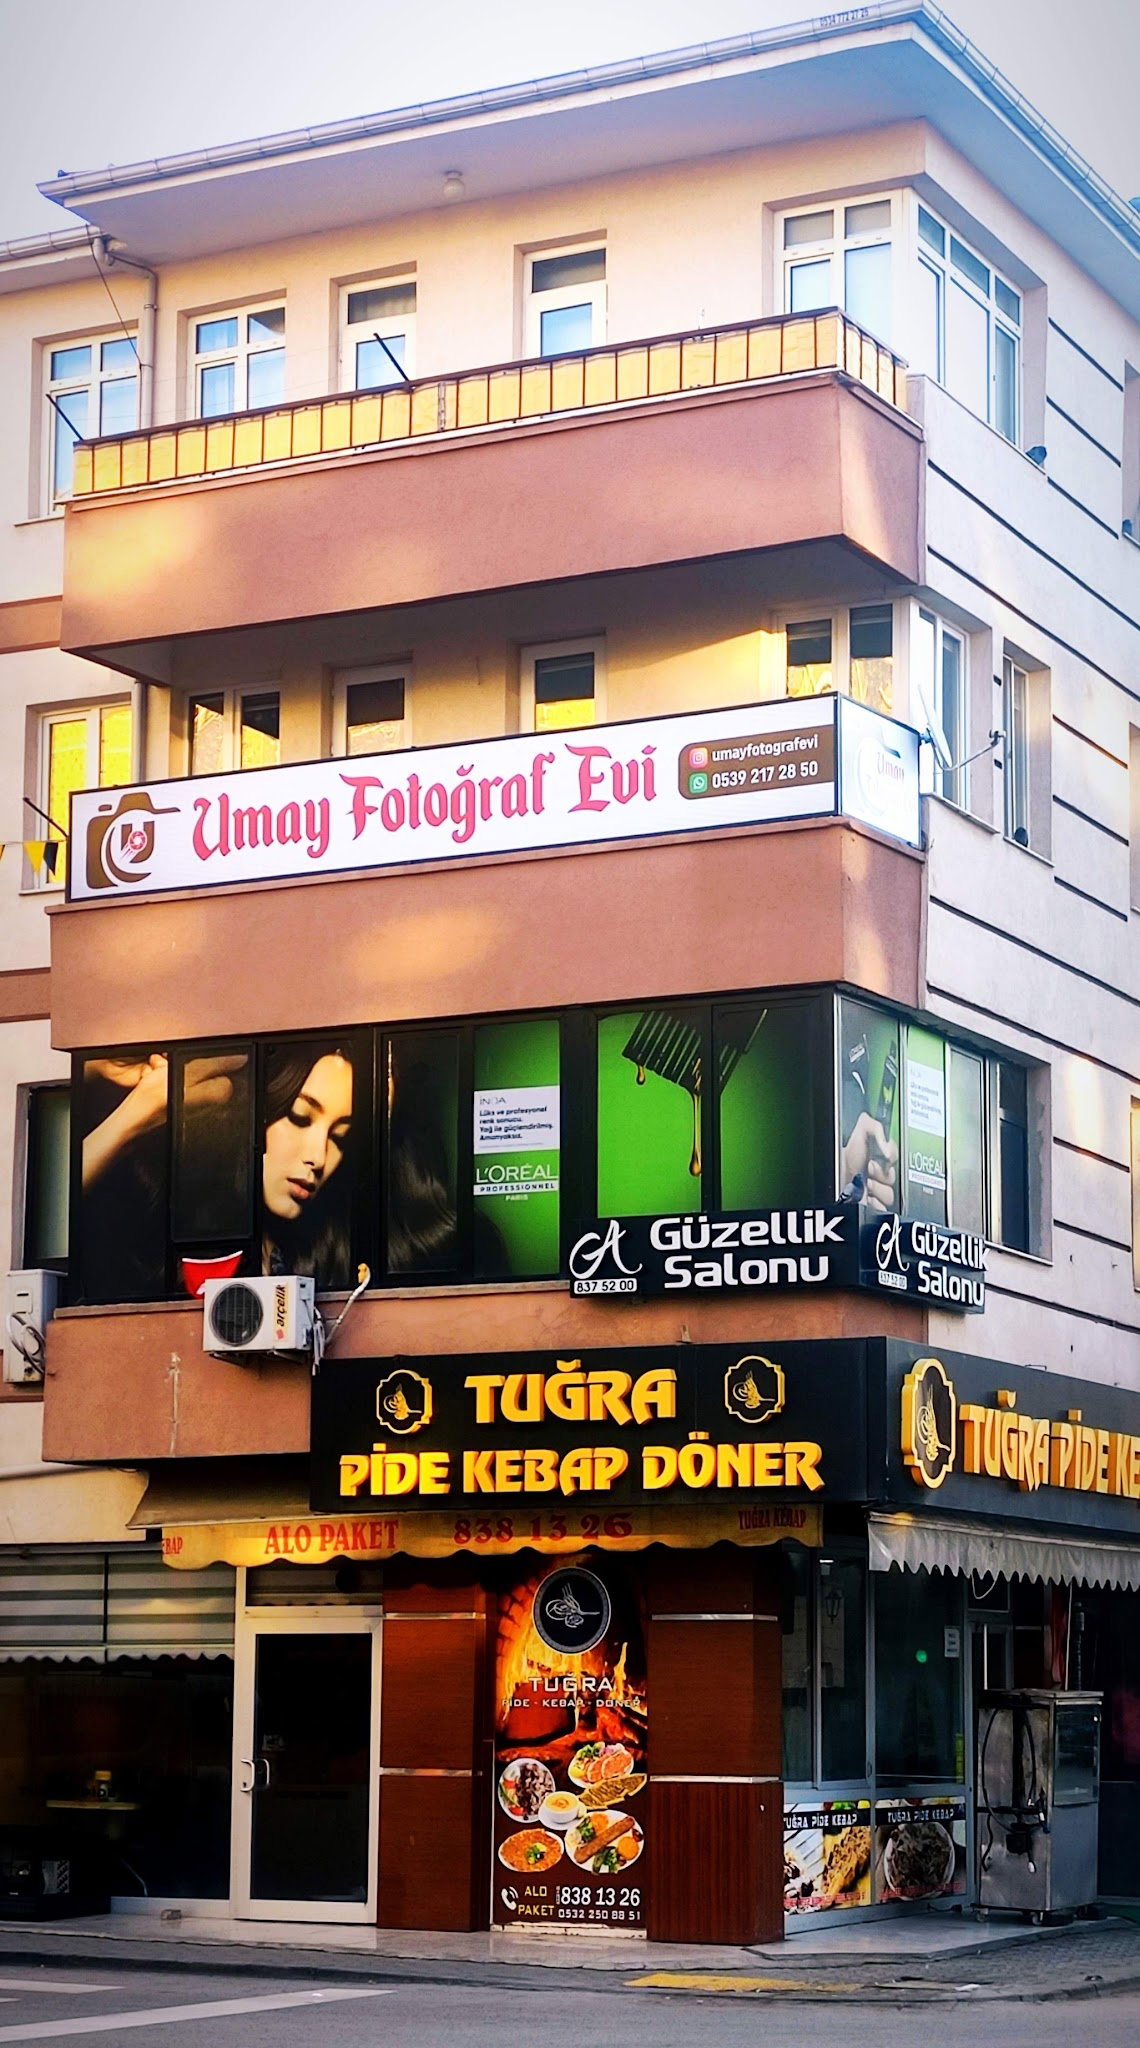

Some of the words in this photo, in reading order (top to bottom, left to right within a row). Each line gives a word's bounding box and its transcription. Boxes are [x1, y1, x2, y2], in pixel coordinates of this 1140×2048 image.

[712, 734, 819, 764] umayfotografevi
[712, 769, 747, 789] 0539
[750, 766, 776, 784] 217
[778, 764, 797, 782] 28
[800, 761, 819, 779] 50
[193, 792, 330, 860] Umay
[339, 752, 555, 843] Fotoğraf
[565, 743, 658, 813] Evi
[479, 1183, 556, 1192] PROFESSIONNEL
[650, 1209, 845, 1250] Güzellik
[911, 1220, 990, 1271] Güzellik
[576, 1280, 598, 1293] 837
[601, 1279, 617, 1292] 52
[619, 1279, 635, 1291] 00
[664, 1253, 829, 1288] Salonu
[917, 1259, 985, 1307] Salonu
[275, 1284, 286, 1327] arçelik
[464, 1358, 677, 1426] TUĞRA
[959, 1389, 1050, 1493] TUĞRA
[1050, 1408, 1110, 1494] PİDE
[339, 1443, 451, 1496] PİDE
[462, 1446, 629, 1497] KEBAP
[642, 1431, 824, 1492] DÖNER
[264, 1524, 312, 1554] ALO
[319, 1519, 399, 1551] PAKET
[453, 1517, 514, 1545] 838
[530, 1515, 568, 1541] 13
[580, 1512, 633, 1539] 26
[528, 1673, 614, 1692] TUĞRA
[542, 1698, 585, 1708] KEBAP
[596, 1697, 641, 1708] DÖNER
[517, 1904, 555, 1916] PAKET
[558, 1908, 585, 1919] 0532
[588, 1909, 608, 1920] 250
[611, 1910, 625, 1920] 88
[628, 1910, 641, 1920] 51
[524, 1885, 548, 1897] ALO
[560, 1886, 591, 1906] 838
[595, 1887, 616, 1906] 13
[619, 1887, 641, 1907] 26
